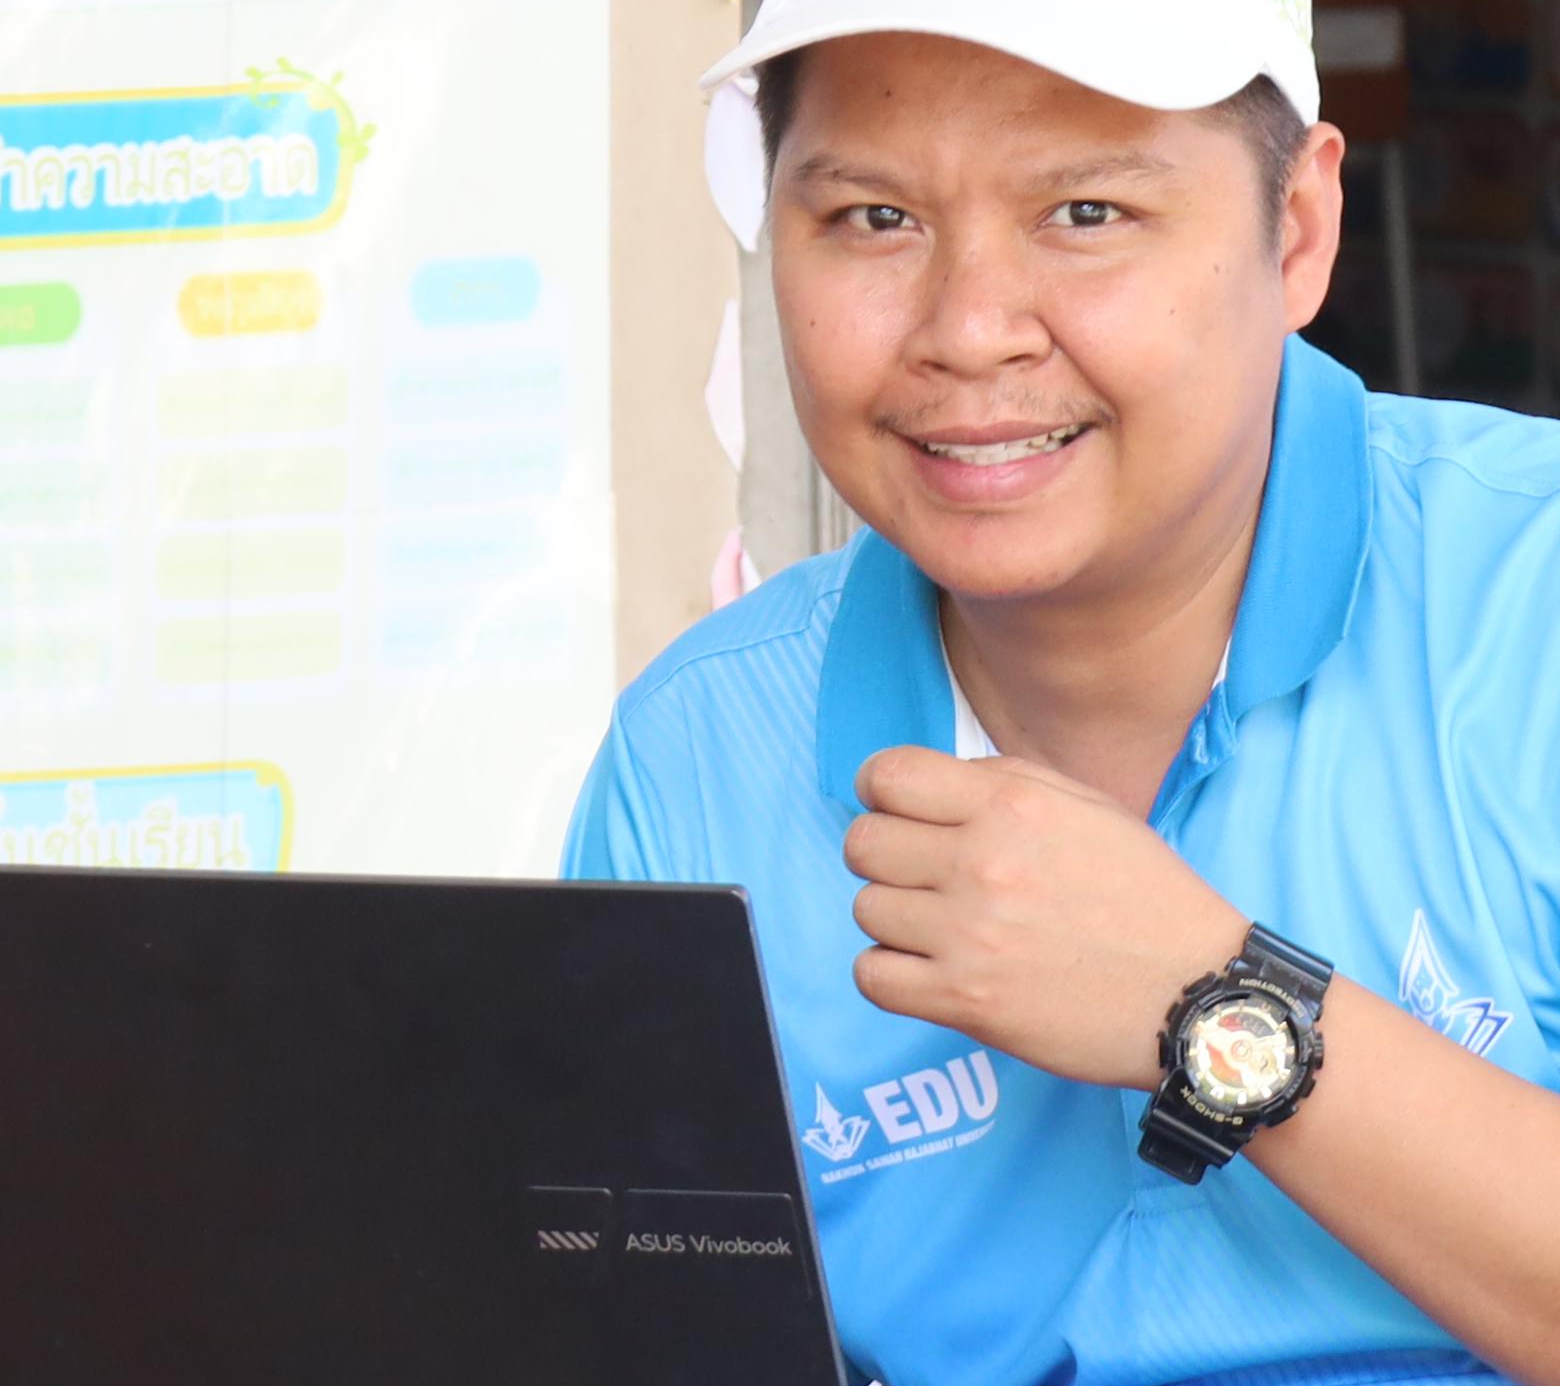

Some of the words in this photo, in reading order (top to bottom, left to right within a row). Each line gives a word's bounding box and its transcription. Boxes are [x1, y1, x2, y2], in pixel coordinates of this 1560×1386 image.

[863, 1049, 999, 1144] EDU
[1181, 1084, 1244, 1127] G-SHOCK
[625, 1232, 686, 1253] ASUS
[688, 1234, 793, 1256] Vivobook
